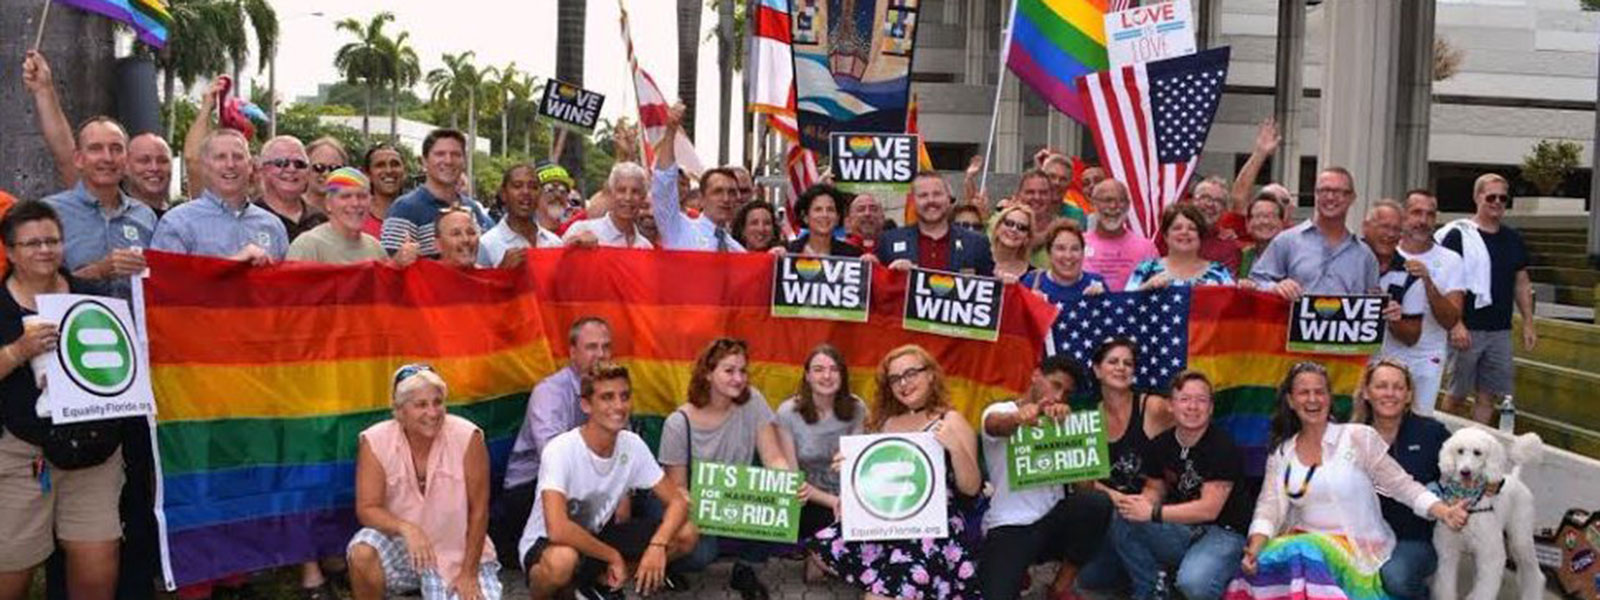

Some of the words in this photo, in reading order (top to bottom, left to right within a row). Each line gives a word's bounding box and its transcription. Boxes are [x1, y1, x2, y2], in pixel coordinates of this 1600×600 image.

[1121, 4, 1174, 28] LOVE
[549, 82, 600, 110] LOVE
[547, 98, 595, 126] WINS
[838, 136, 911, 158] LOVE
[839, 159, 912, 181] WINS
[782, 257, 861, 284] LOVE
[782, 281, 860, 308] WINS
[915, 272, 995, 303] LOVE
[915, 295, 991, 327] WINS
[1300, 296, 1382, 320] LOVE
[1300, 319, 1379, 342] WINS
[1014, 445, 1031, 456] FOR
[1086, 436, 1097, 447] IN
[1015, 446, 1101, 477] FLORIDA
[698, 461, 738, 488] IT'S
[746, 466, 799, 495] TIME
[701, 488, 720, 499] FOR
[778, 497, 790, 507] IN
[698, 499, 790, 529] FLORIDA
